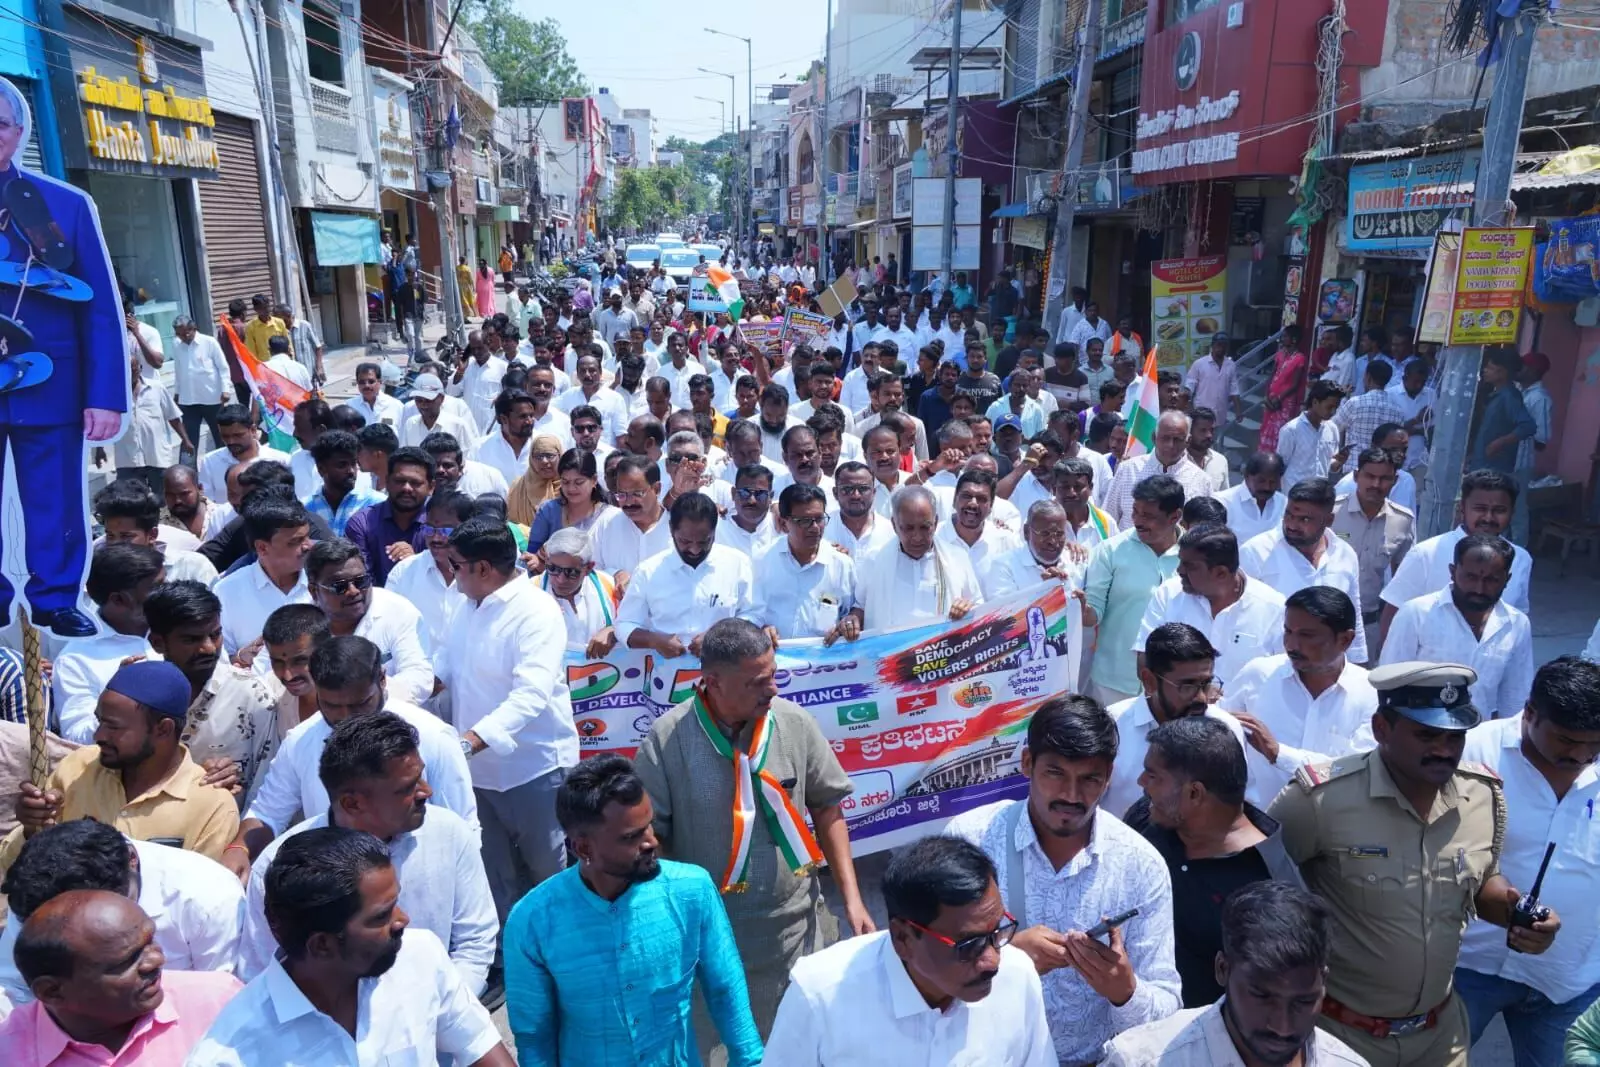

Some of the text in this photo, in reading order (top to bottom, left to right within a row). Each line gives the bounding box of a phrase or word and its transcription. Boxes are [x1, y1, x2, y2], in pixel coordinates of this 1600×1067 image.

[150, 120, 220, 169] Jewellers
[1355, 186, 1406, 211] NOORIE
[1169, 267, 1193, 275] HOTEL
[915, 640, 949, 655] SAVE
[916, 627, 992, 665] DEMOCRACY
[974, 638, 1019, 662] RIGHTS
[912, 658, 948, 675] SAVE
[861, 790, 891, 808] ನಗರ
